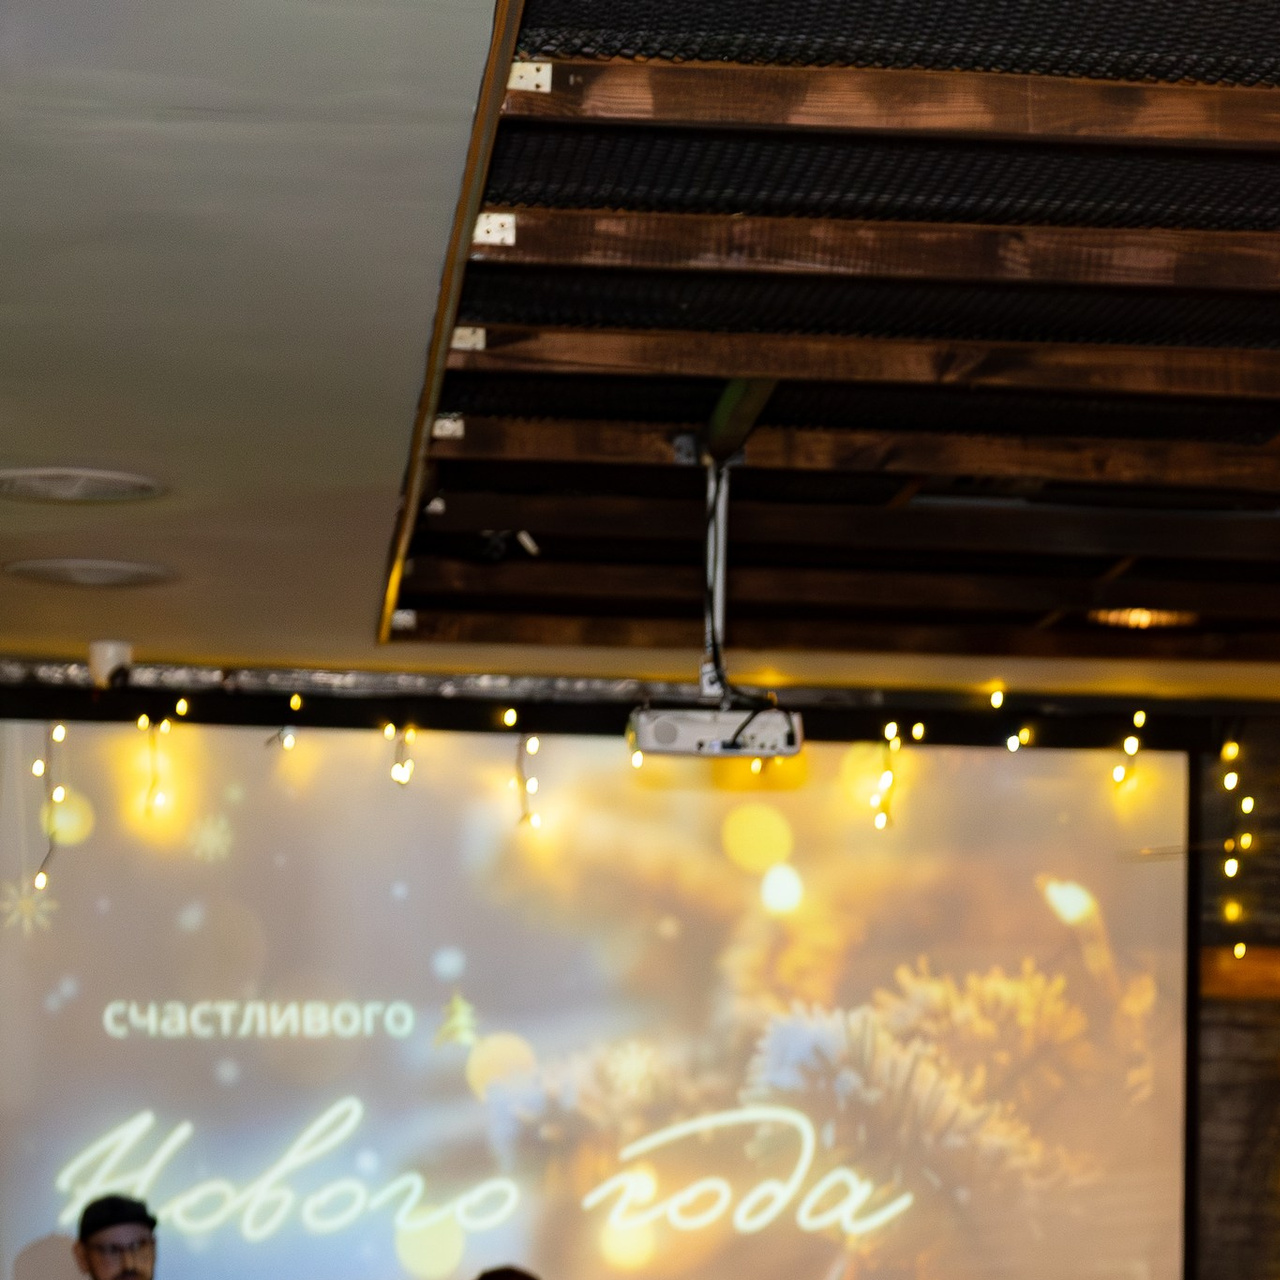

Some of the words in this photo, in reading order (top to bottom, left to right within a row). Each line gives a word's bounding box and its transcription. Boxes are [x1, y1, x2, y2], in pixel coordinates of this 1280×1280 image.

[103, 998, 415, 1039] счастливого
[56, 1096, 520, 1242] Нового
[581, 1105, 914, 1236] года
